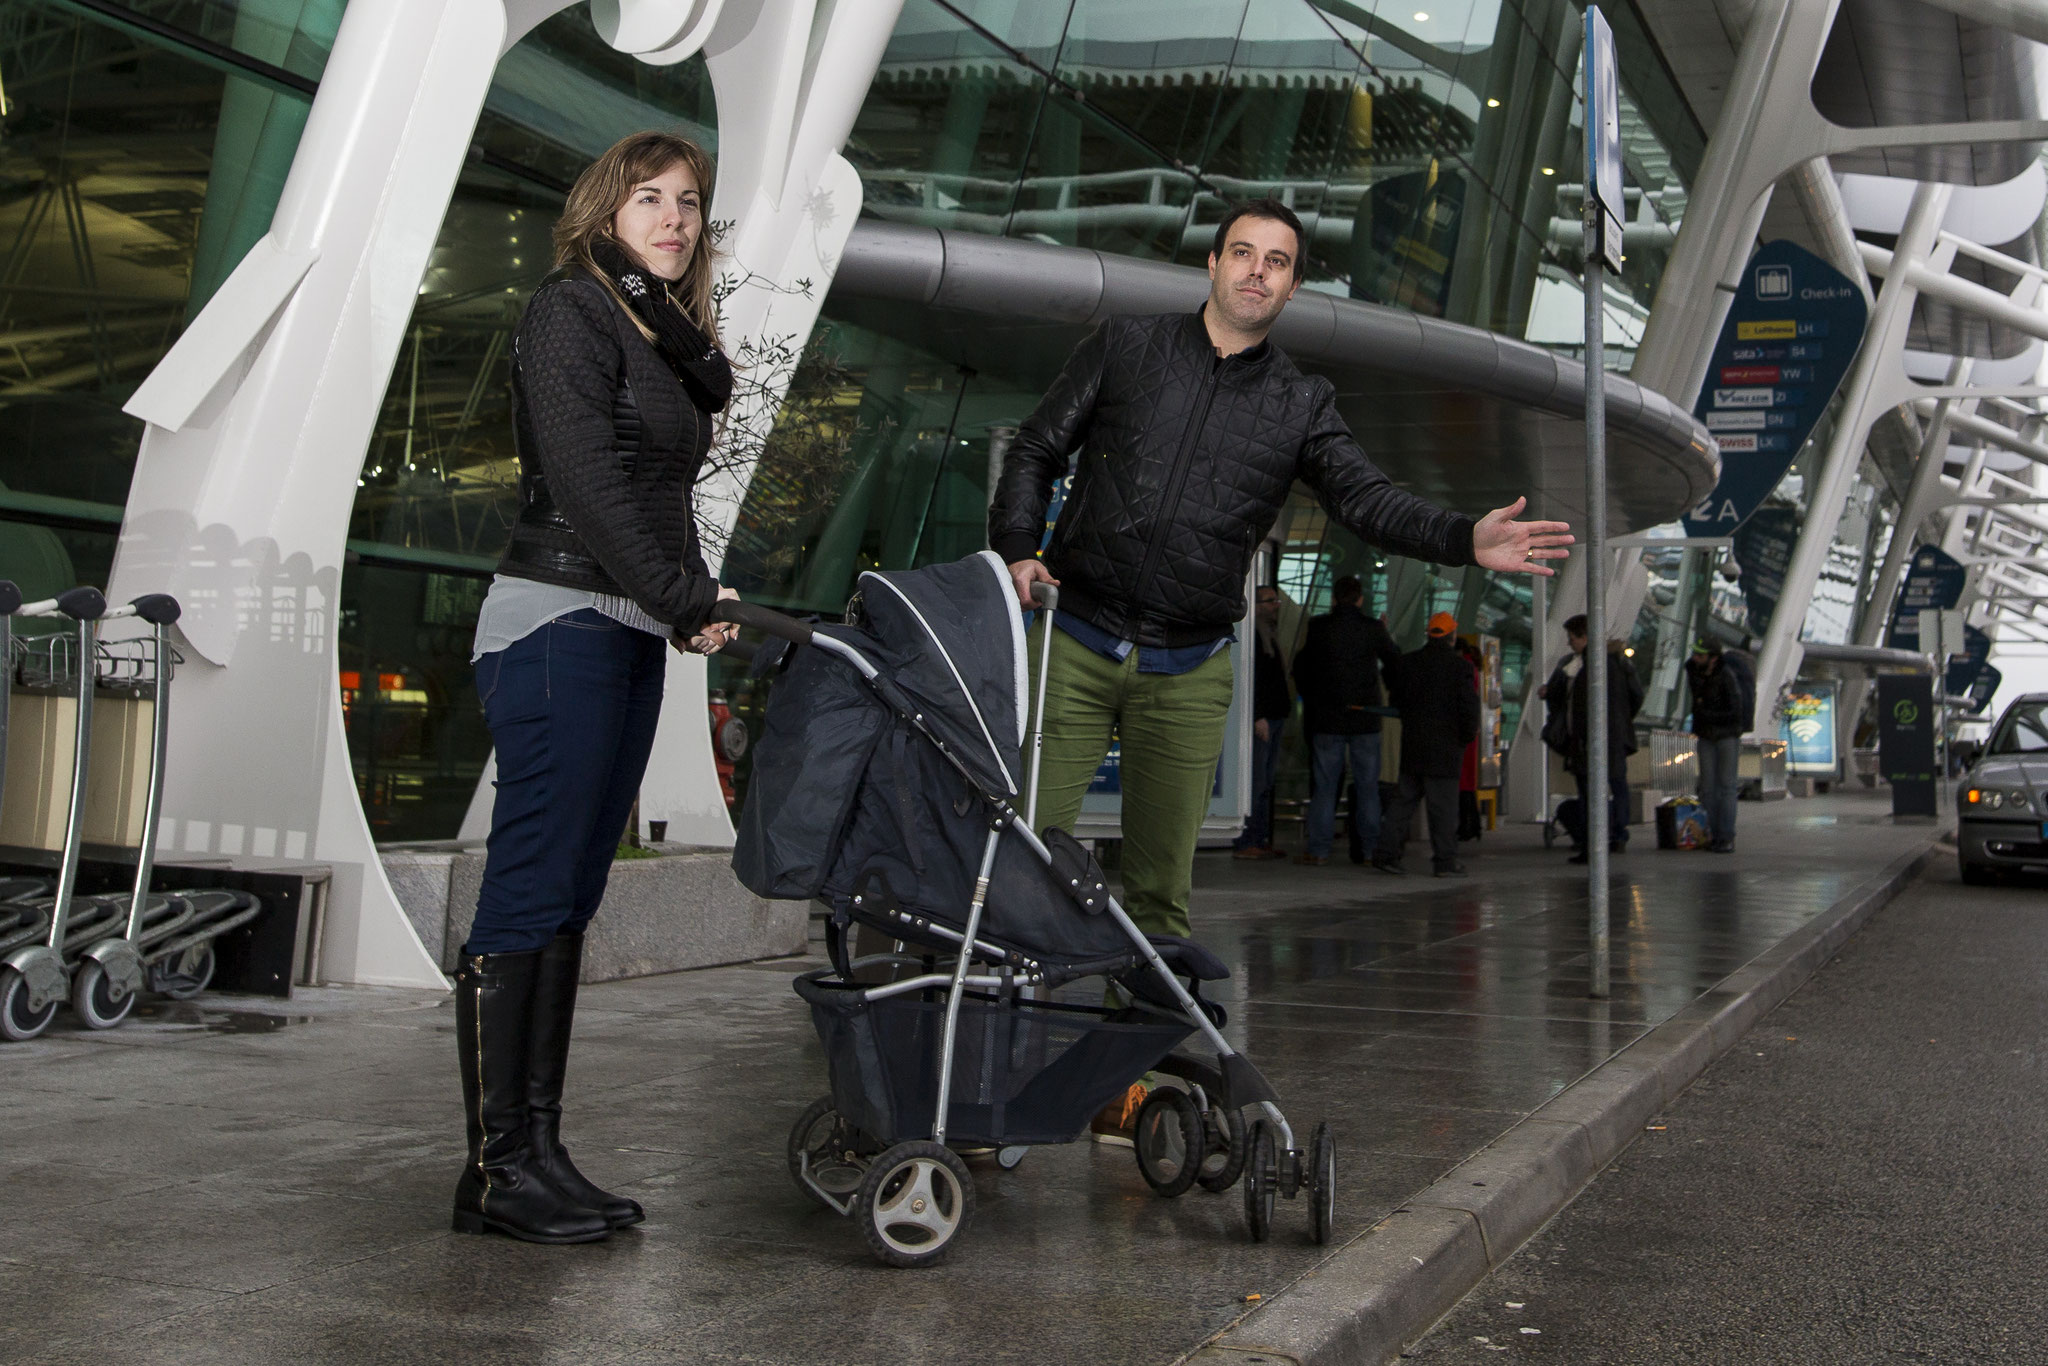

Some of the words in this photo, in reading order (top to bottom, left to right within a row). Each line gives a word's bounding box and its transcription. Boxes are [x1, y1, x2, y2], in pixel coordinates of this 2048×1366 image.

[1800, 287, 1852, 300] Check-in
[1798, 323, 1813, 334] LH
[1733, 348, 1755, 360] sata
[1782, 368, 1801, 379] YW
[1767, 414, 1783, 425] SN
[1719, 438, 1754, 448] SWISS
[1760, 438, 1773, 448] LX
[1717, 499, 1739, 522] A
